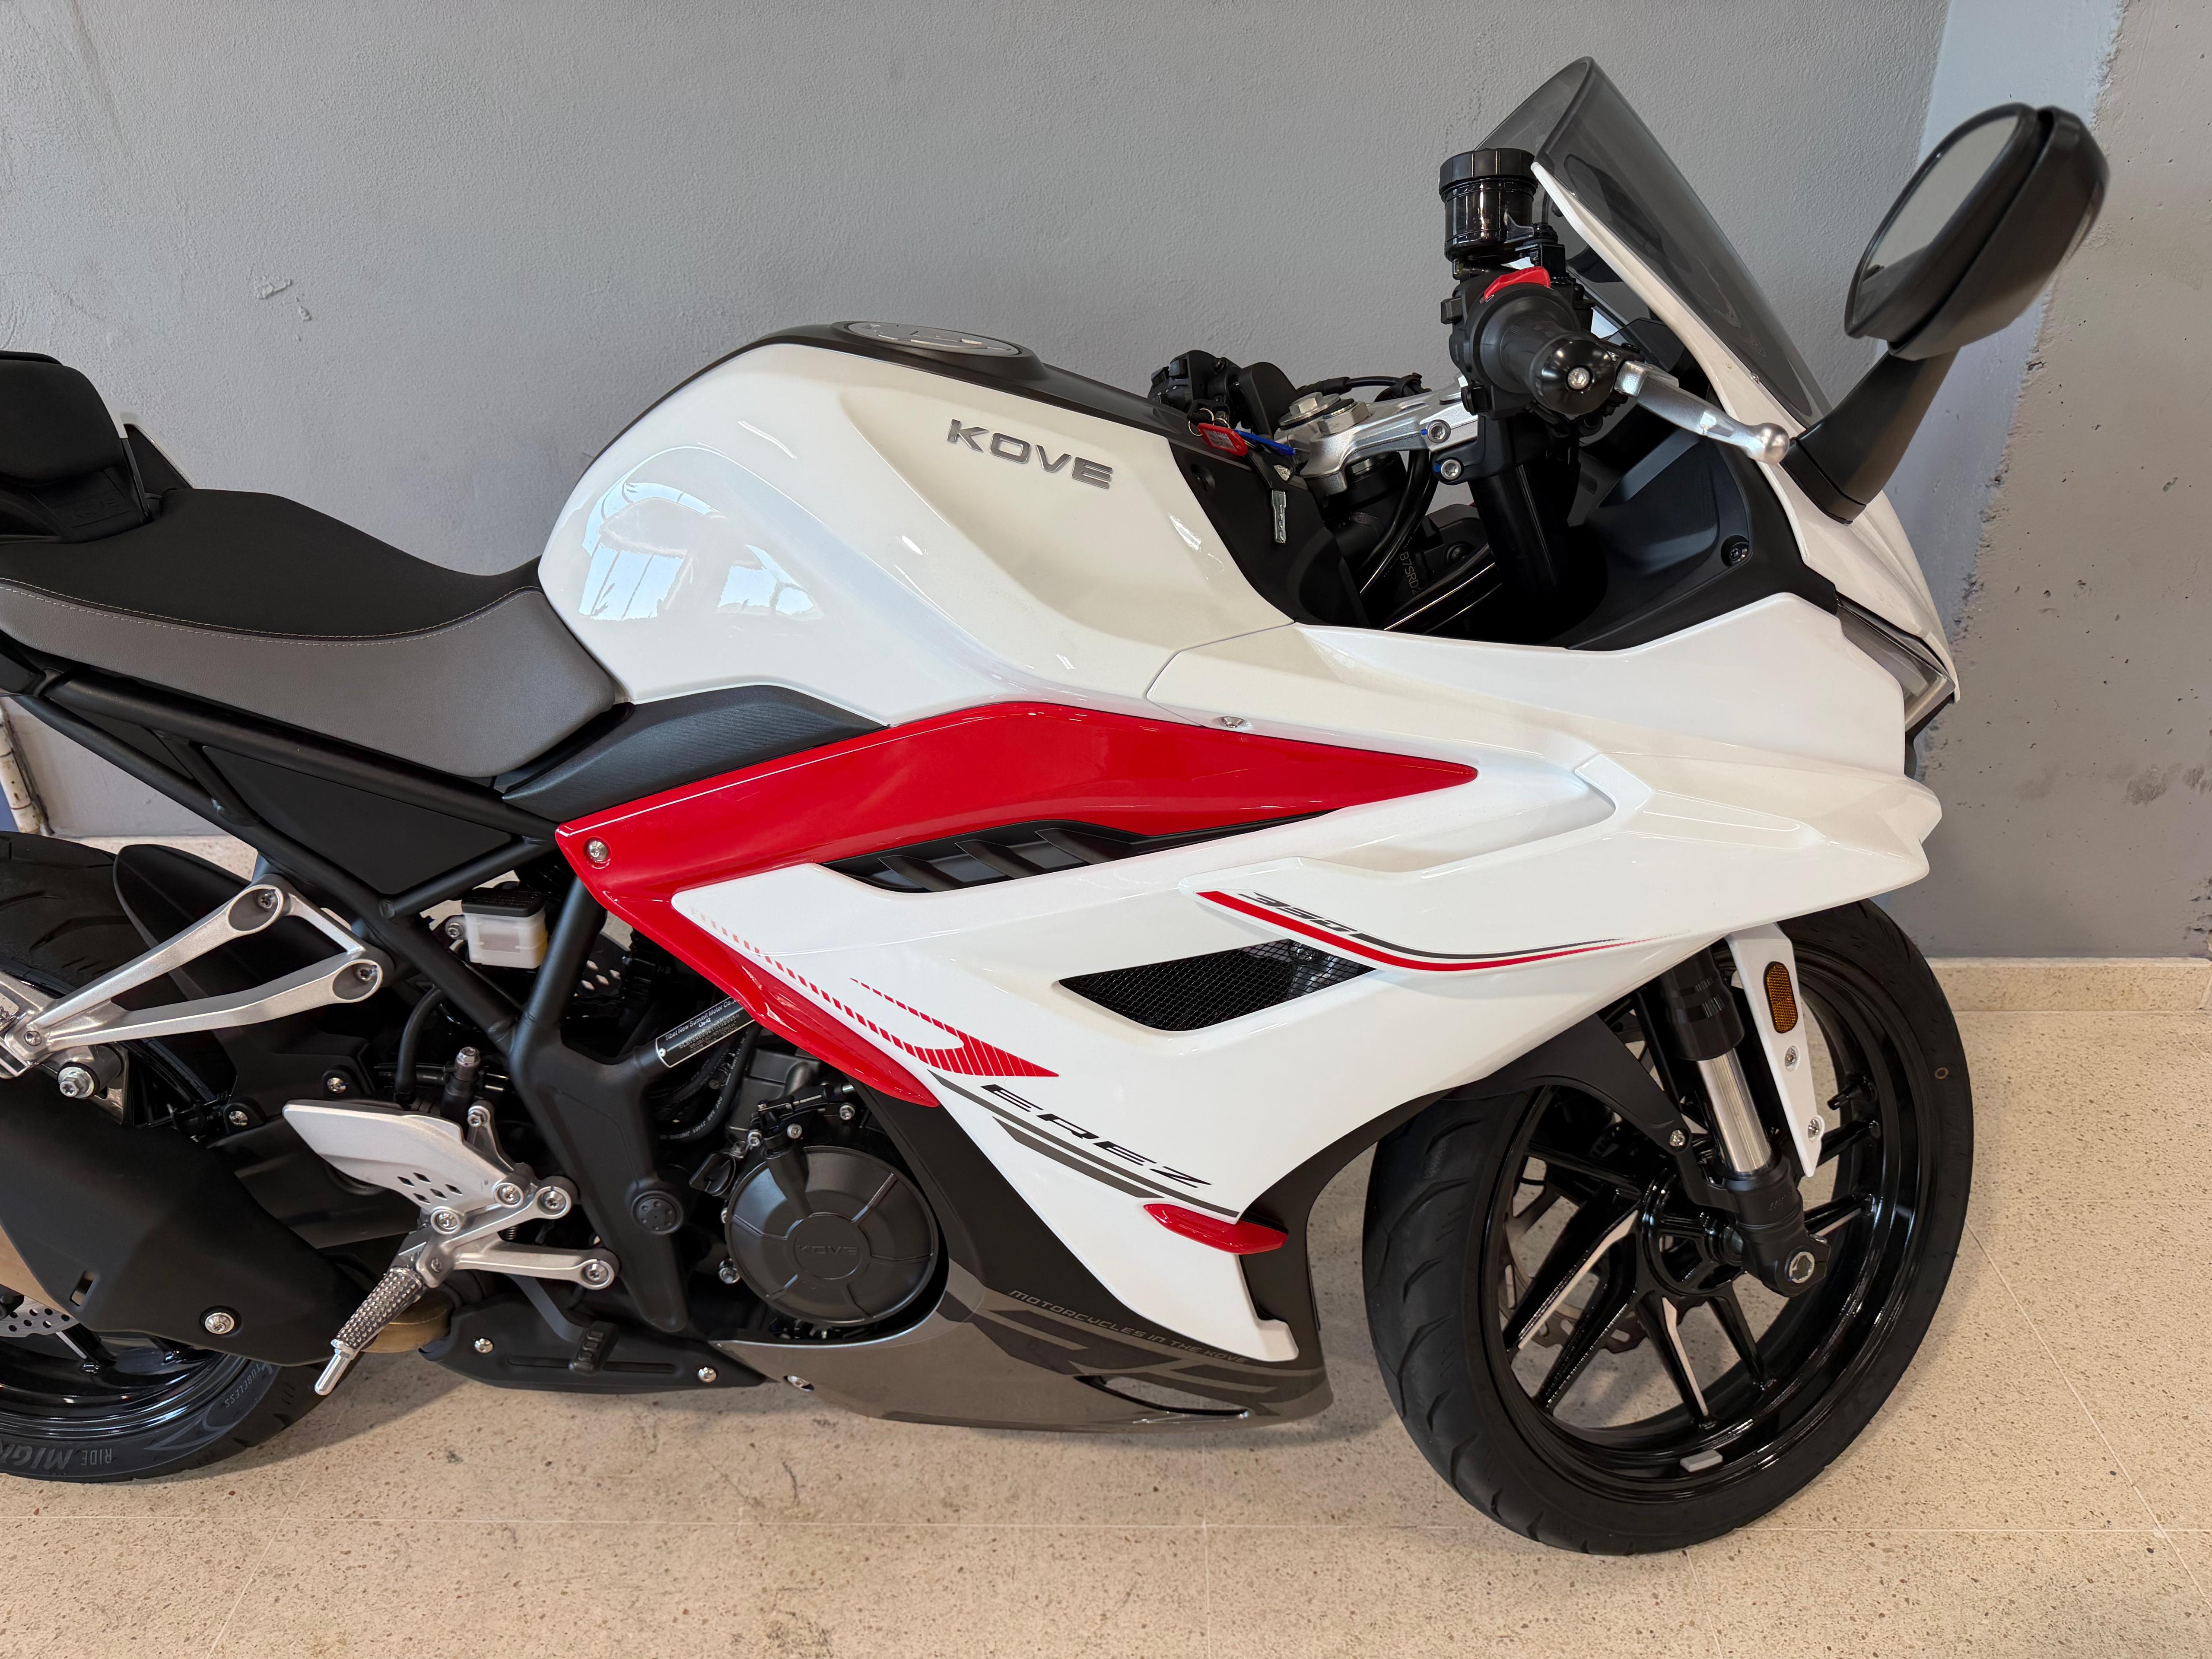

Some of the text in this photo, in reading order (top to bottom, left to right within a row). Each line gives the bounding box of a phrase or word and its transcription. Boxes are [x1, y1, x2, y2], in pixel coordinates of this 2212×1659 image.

[947, 419, 1113, 490] KOVE
[1237, 892, 1358, 932] 350
[665, 1031, 678, 1041] Tibet
[677, 1024, 689, 1034] New
[689, 1013, 709, 1027] Summit
[709, 1005, 723, 1017] Motor
[980, 1084, 1213, 1189] EREZ
[798, 1245, 859, 1255] KOVE
[1010, 1290, 1146, 1337] MOTORCYCLES
[1170, 1340, 1202, 1352] THE
[1204, 1350, 1249, 1363] KOVE
[225, 1363, 262, 1408] TUBELESS
[81, 1449, 112, 1465] RIDE
